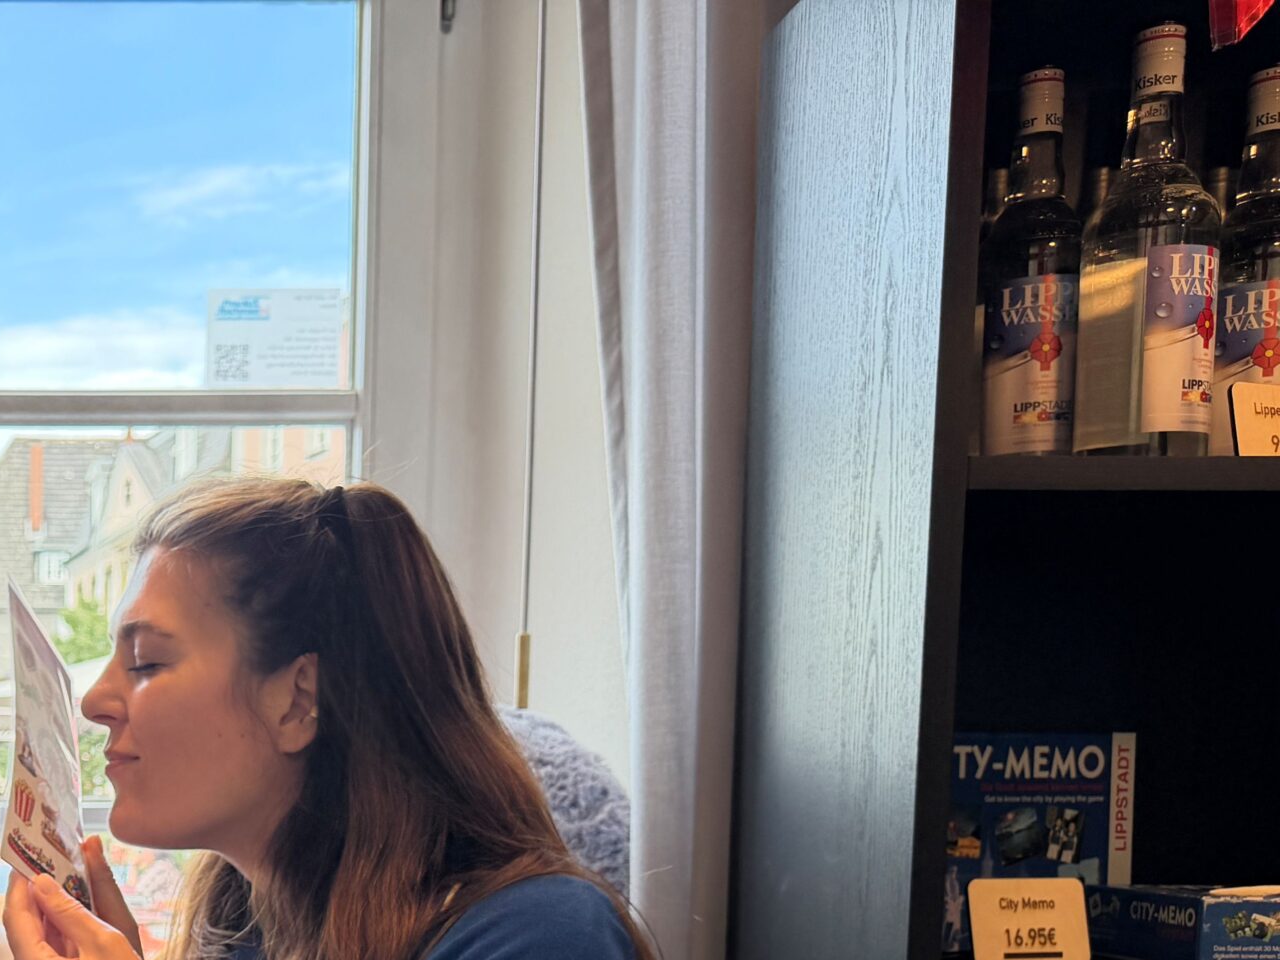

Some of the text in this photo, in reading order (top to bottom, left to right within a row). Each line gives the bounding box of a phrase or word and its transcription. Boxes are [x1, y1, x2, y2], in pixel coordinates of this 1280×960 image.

[1135, 73, 1178, 92] Kisker
[1045, 112, 1064, 126] Kis
[1001, 282, 1073, 311] LIPP
[1114, 745, 1131, 852] LIPPSTADT
[998, 897, 1055, 913] City Memo
[1129, 900, 1196, 928] CITY-MEMO
[1004, 928, 1058, 947] 16.95€
